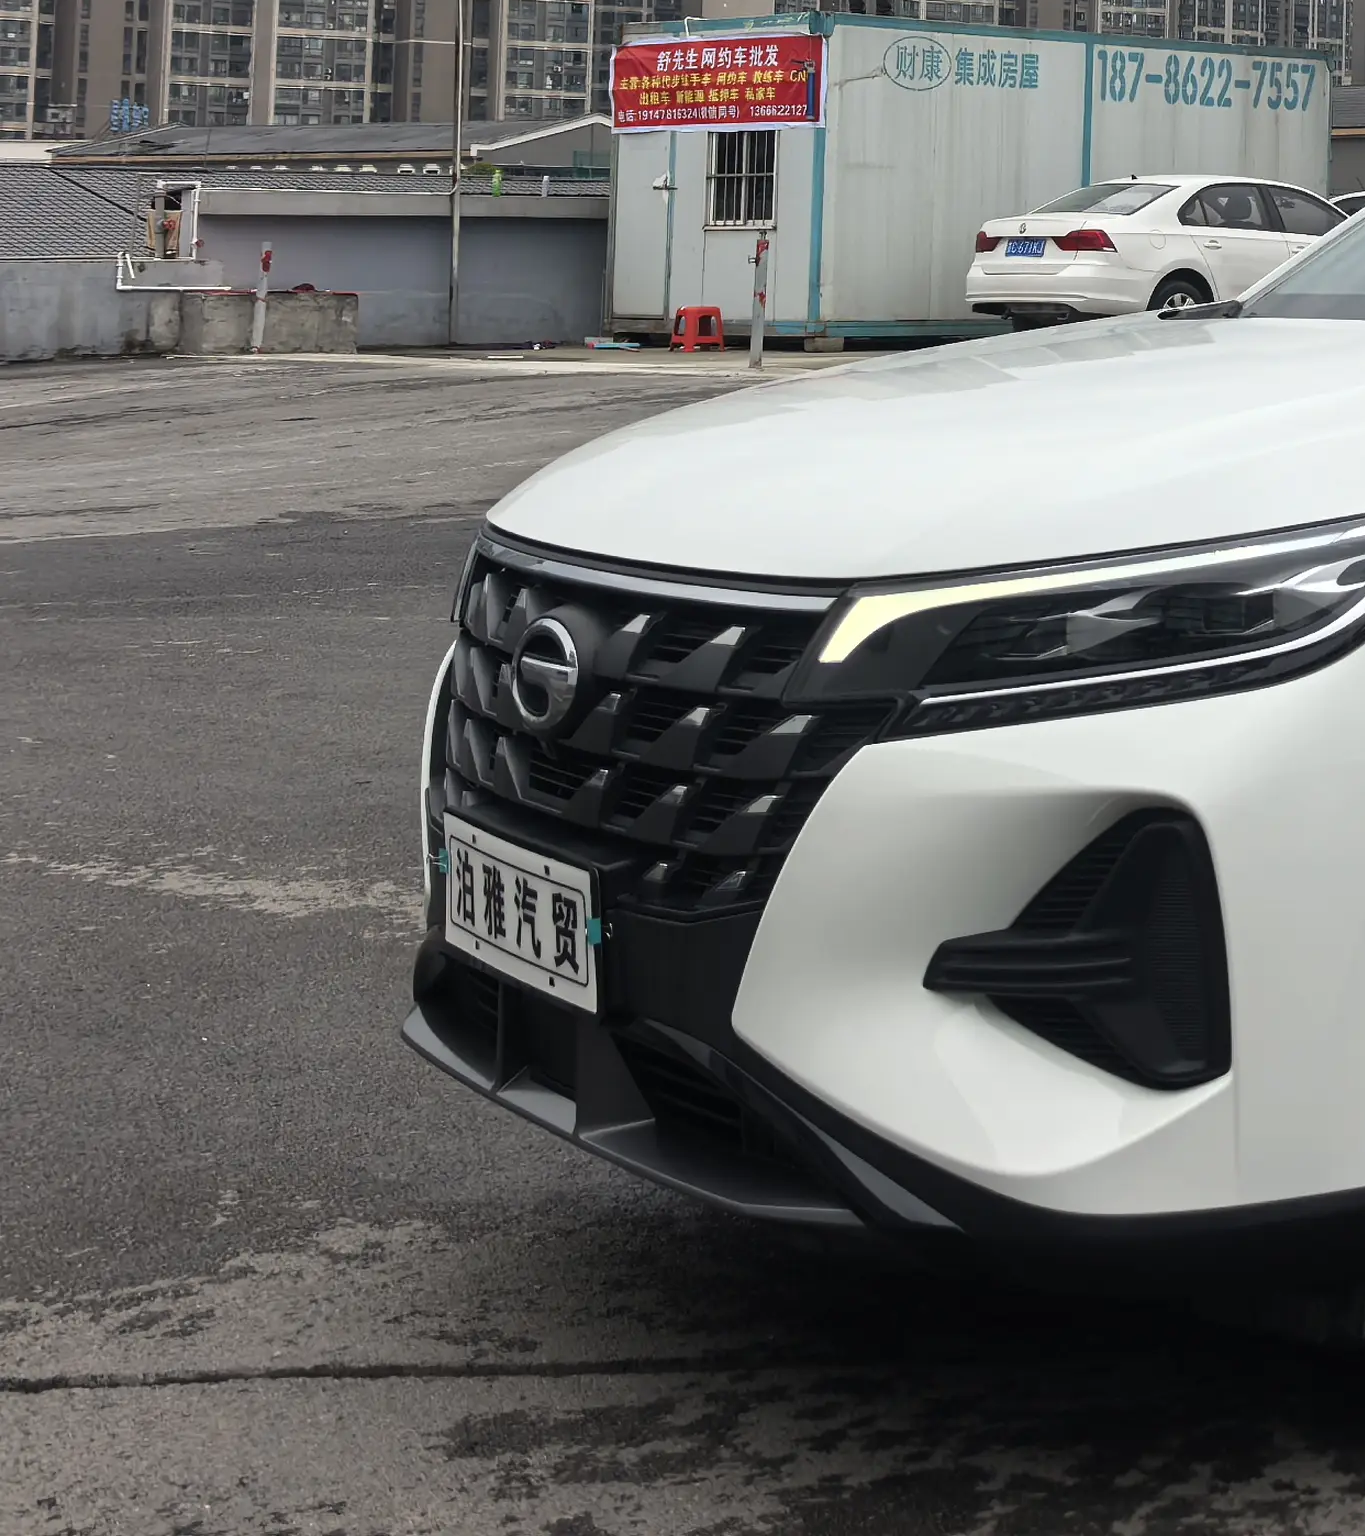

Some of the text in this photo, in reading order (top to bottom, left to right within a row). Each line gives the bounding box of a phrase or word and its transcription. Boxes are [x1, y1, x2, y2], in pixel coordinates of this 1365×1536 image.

[656, 44, 779, 72] 舒先生网约车批发
[895, 45, 943, 82] 财康
[955, 47, 1040, 89] 集成房屋
[716, 71, 748, 86] 网约车
[790, 68, 808, 83] CN
[1097, 50, 1316, 111] 187-8622-7557
[639, 91, 671, 106] 出租车
[750, 104, 808, 117] 1366622127
[456, 848, 580, 975] 泊雅汽贸
